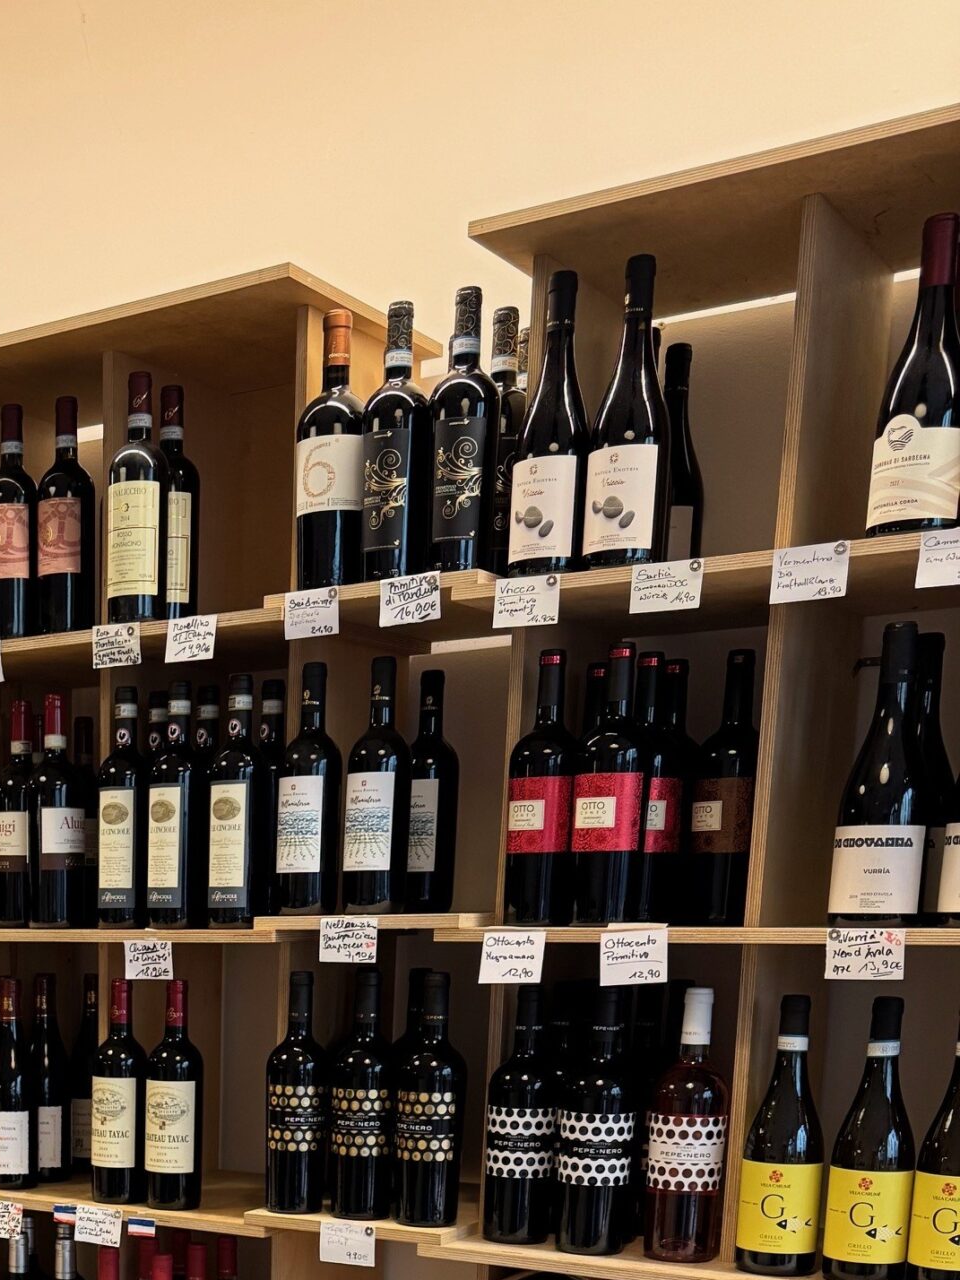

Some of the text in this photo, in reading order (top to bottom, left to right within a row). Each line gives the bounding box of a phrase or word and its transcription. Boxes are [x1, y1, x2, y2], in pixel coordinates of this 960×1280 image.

[513, 803, 535, 813] OTTO
[581, 801, 606, 812] OTTO
[843, 836, 914, 848] GIOVANNA
[502, 967, 534, 979] 12,90
[629, 969, 661, 980] 12,90
[109, 1130, 130, 1139] TAYAC
[168, 1134, 190, 1143] TAYAC
[760, 1193, 788, 1220] G
[849, 1202, 876, 1228] G
[932, 1207, 959, 1234] G
[848, 1242, 873, 1250] GRILLO
